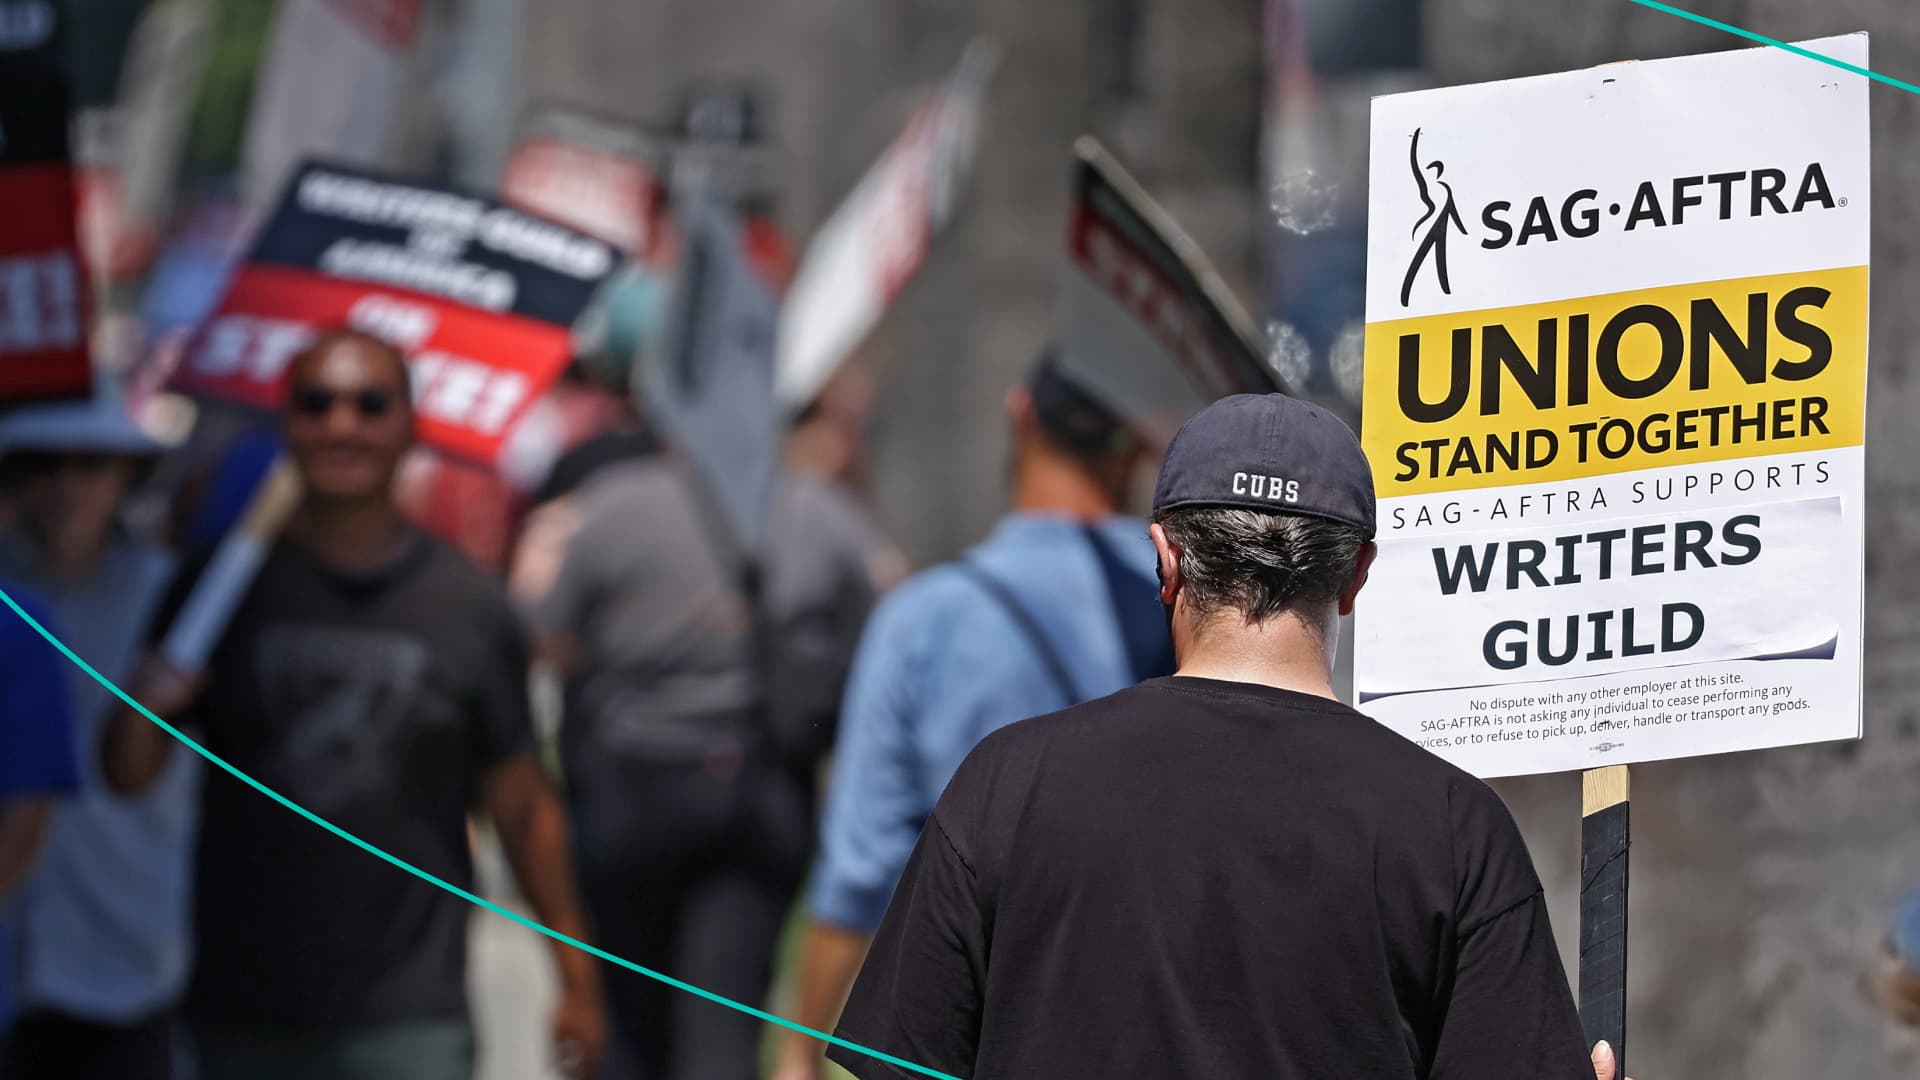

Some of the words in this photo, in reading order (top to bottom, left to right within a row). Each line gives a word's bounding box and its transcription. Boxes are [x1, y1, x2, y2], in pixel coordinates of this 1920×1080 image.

[1398, 287, 1832, 423] UNIONS
[1395, 429, 1558, 481] STAND
[1569, 397, 1830, 463] TOGETHER
[1233, 473, 1298, 502] CUBS
[1393, 488, 1607, 529] SAG-AFTRA
[1632, 461, 1828, 503] SUPPORTS
[1432, 515, 1761, 595] WRITERS
[1483, 603, 1704, 670] GUILD
[1420, 715, 1490, 732] SAG-AFTRA
[1494, 714, 1503, 725] is
[1506, 713, 1527, 724] not
[1529, 709, 1567, 723] asking
[1570, 708, 1591, 721] any
[1593, 697, 1649, 719] individual
[1652, 698, 1664, 709] to
[1667, 695, 1700, 707] cease
[1703, 687, 1769, 706] performing
[1771, 686, 1793, 698] any
[1454, 735, 1468, 745] or
[1470, 733, 1484, 744] to
[1486, 729, 1524, 742] refuse
[1526, 728, 1539, 739] to
[1542, 724, 1566, 741] pick
[1569, 725, 1587, 737] up,
[1589, 719, 1630, 733] deliver,
[1633, 711, 1672, 727] handle
[1675, 712, 1688, 723] or
[1690, 705, 1745, 721] transport
[1748, 704, 1770, 717] any
[1772, 698, 1811, 716] goods.
[1470, 699, 1487, 711] No
[1490, 696, 1535, 711] dispute
[1537, 692, 1564, 705] with
[1566, 692, 1587, 705] any
[1589, 686, 1621, 700] other
[1623, 680, 1677, 697] employer
[1680, 678, 1692, 689] at
[1695, 675, 1717, 688] this
[1719, 673, 1744, 685] site.
